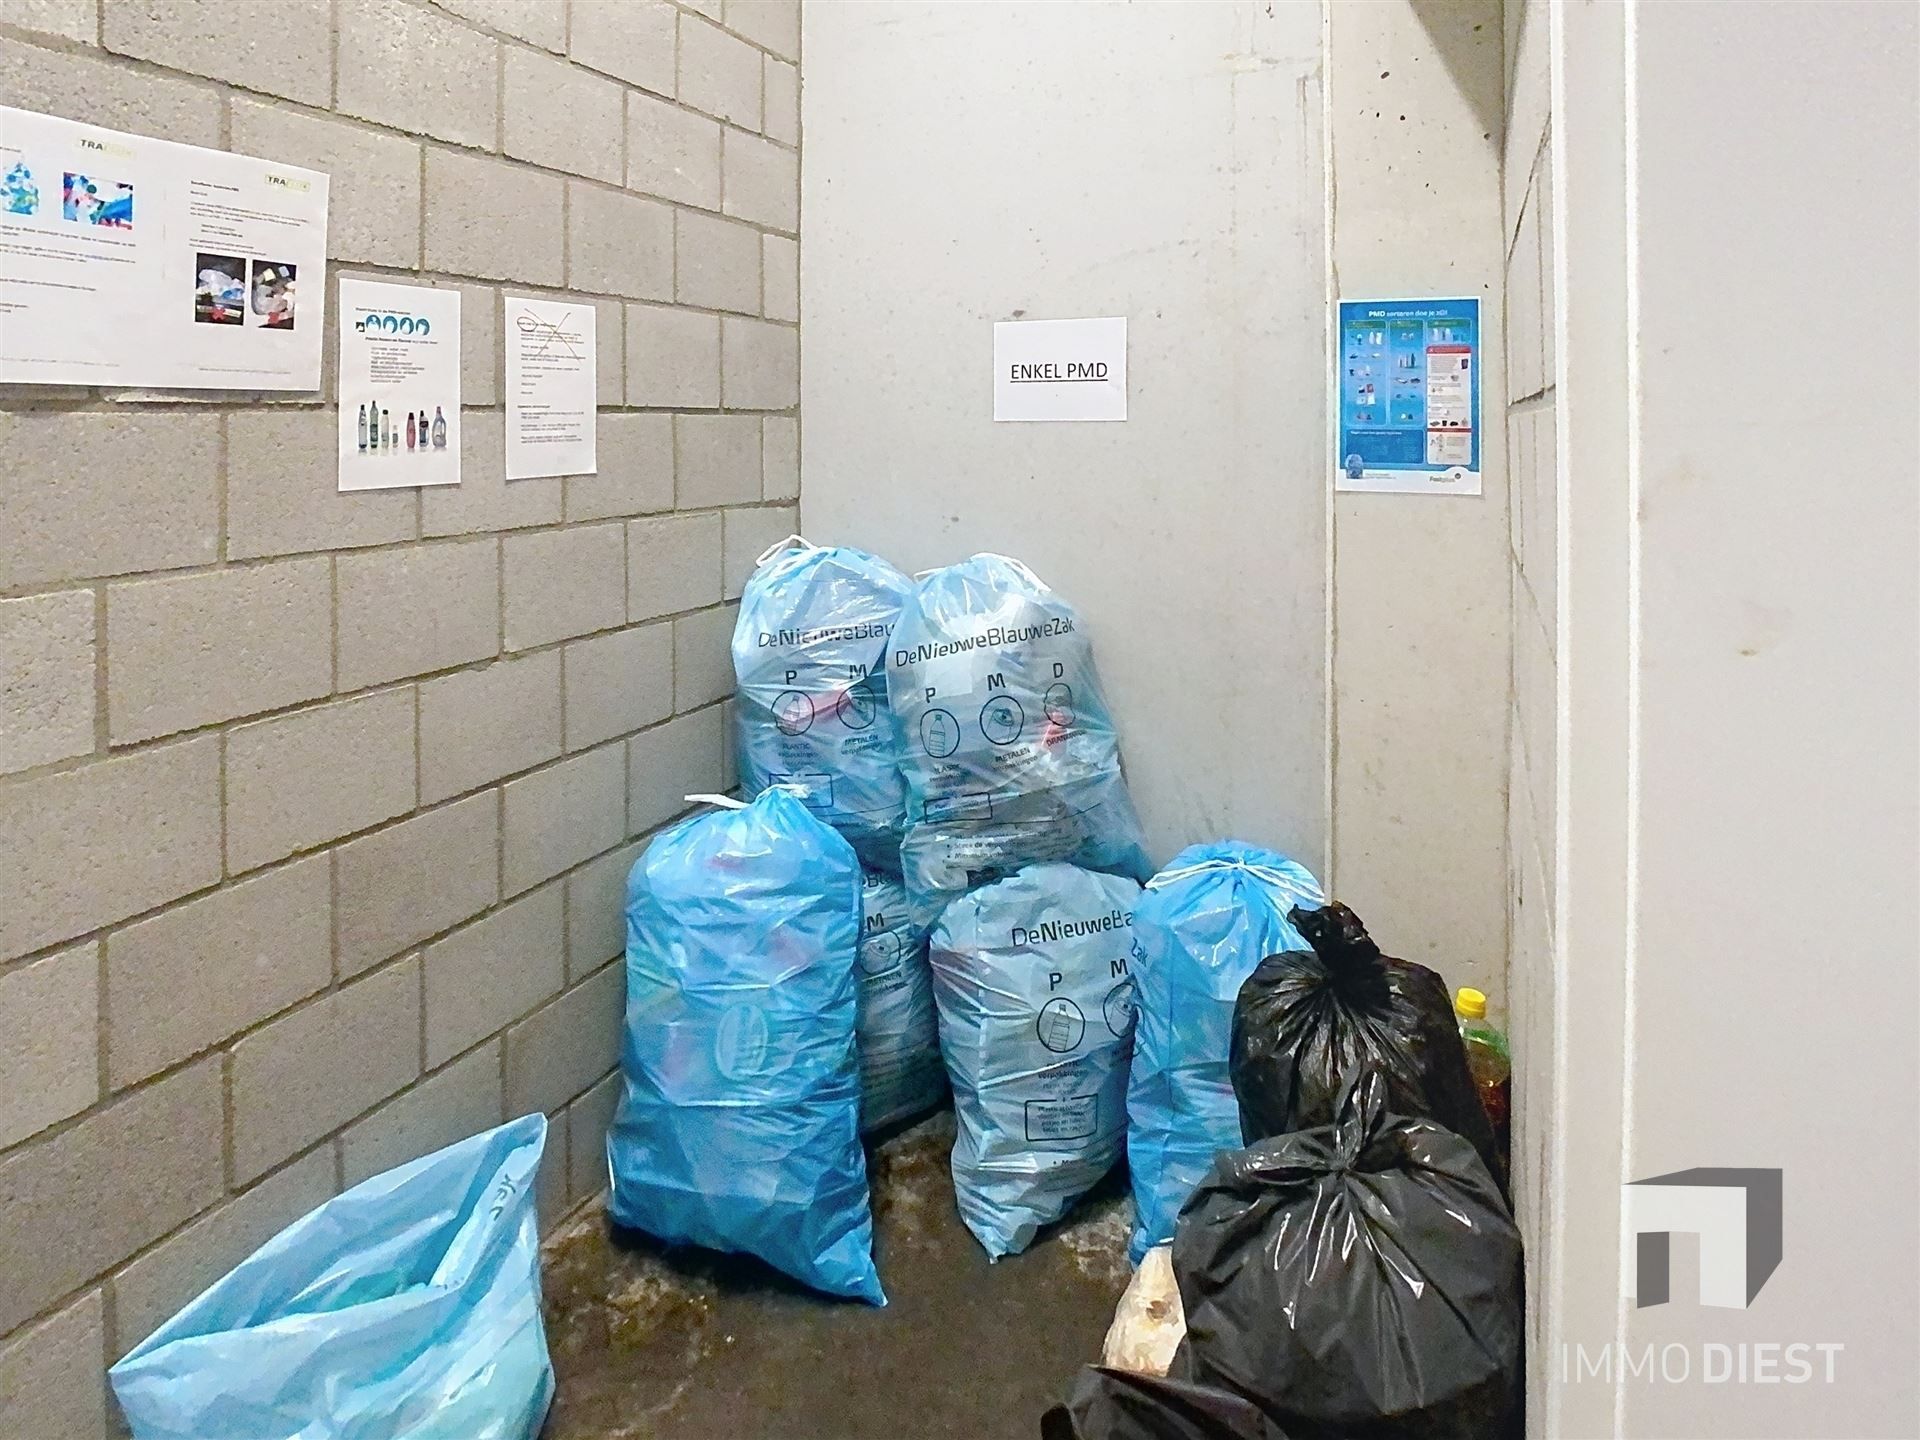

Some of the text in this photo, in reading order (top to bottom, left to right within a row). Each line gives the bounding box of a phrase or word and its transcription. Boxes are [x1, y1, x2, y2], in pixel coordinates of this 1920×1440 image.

[1368, 310, 1386, 318] PMD
[1414, 309, 1428, 317] doe
[1428, 309, 1435, 318] je
[1010, 362, 1108, 380] ENKEL PMD
[895, 616, 1076, 668] DeNieuweBlauweZak
[785, 663, 868, 686] P M
[925, 662, 1064, 704] P M D
[994, 746, 1031, 763] METALEN
[866, 912, 883, 932] M
[1049, 957, 1129, 991] P M
